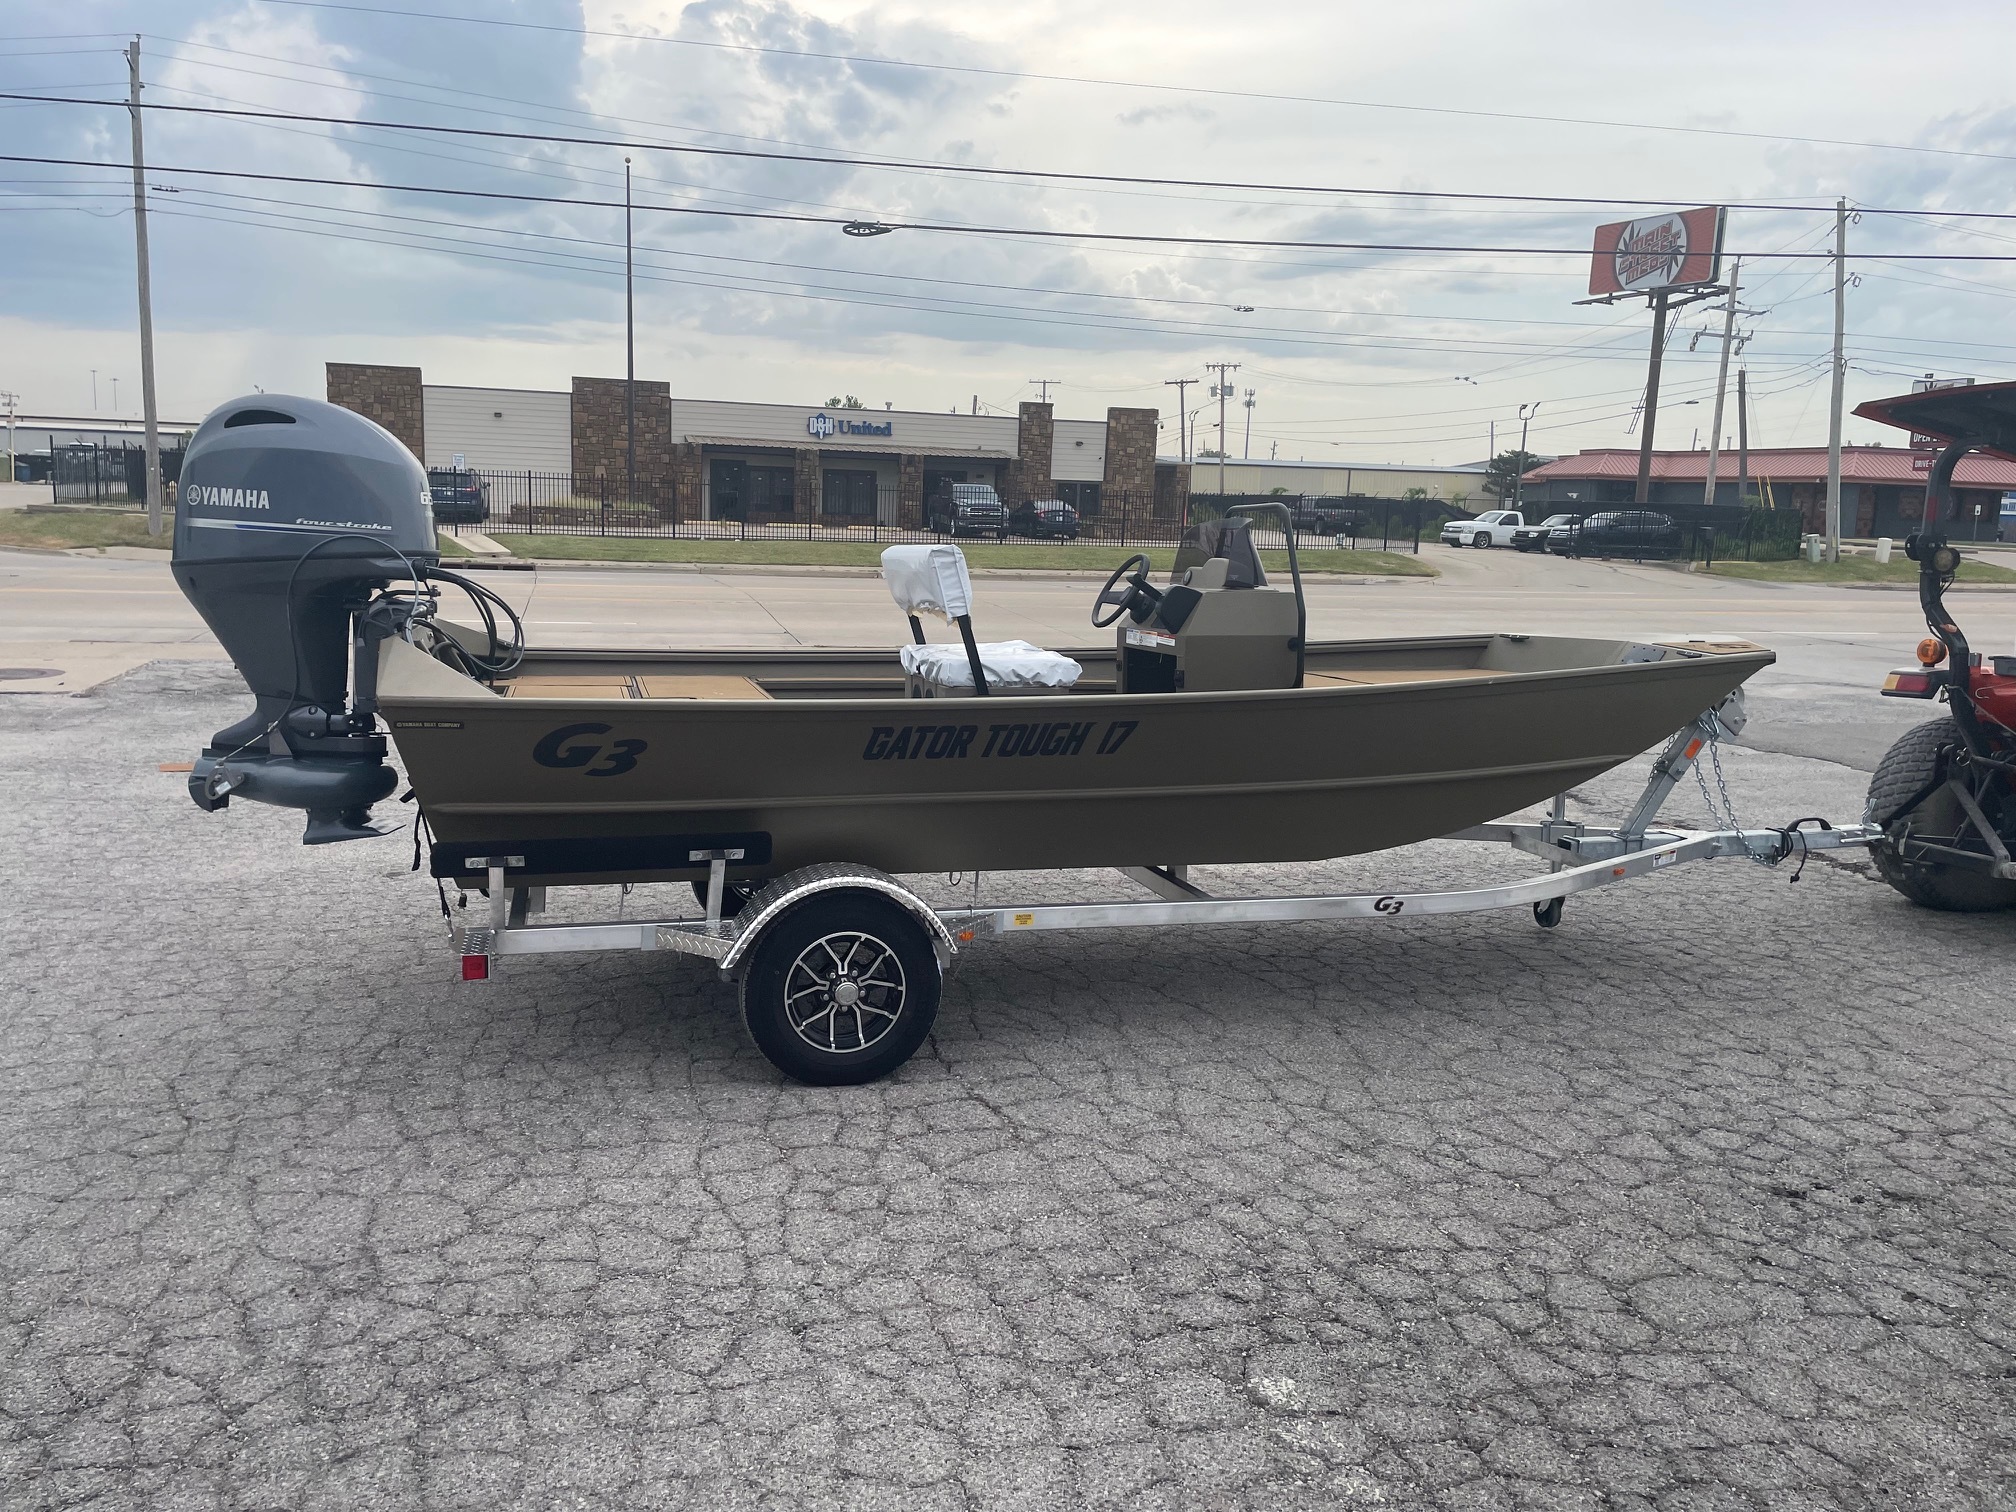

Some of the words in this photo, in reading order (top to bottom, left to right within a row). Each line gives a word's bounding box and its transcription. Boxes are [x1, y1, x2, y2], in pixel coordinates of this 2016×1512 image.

[1618, 229, 1681, 275] STREET
[1629, 220, 1674, 252] MAIN
[1625, 252, 1672, 285] MEDS
[809, 417, 834, 440] D&H
[838, 420, 892, 436] United
[202, 486, 270, 509] YAMAHA
[533, 722, 648, 777] G3
[862, 725, 978, 760] GATOR
[980, 721, 1098, 758] TOUGH
[1096, 720, 1140, 755] 17
[1373, 896, 1404, 915] G3
